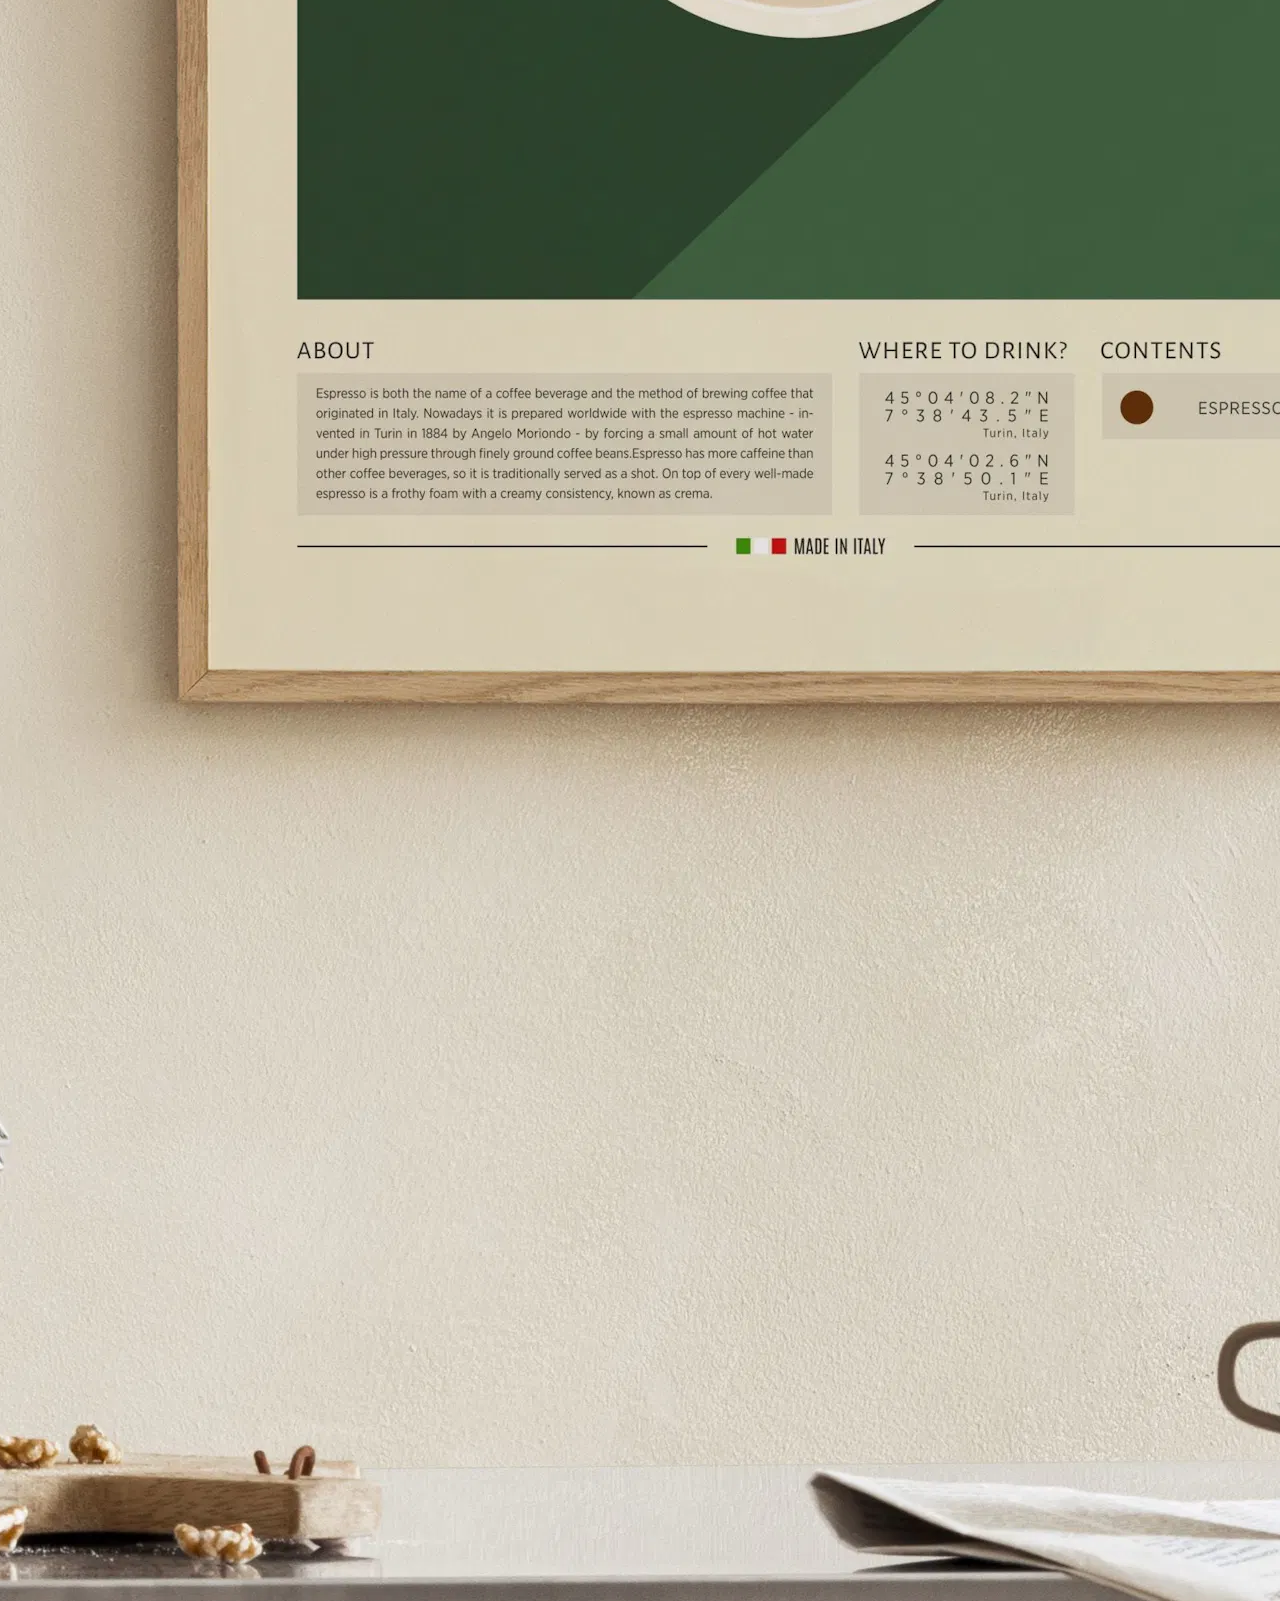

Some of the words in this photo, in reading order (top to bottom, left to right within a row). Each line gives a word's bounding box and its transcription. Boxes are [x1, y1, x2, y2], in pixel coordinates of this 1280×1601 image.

[297, 341, 374, 359] ABOUT
[859, 341, 942, 359] WHERE
[948, 341, 976, 359] TO
[986, 341, 1067, 359] DRINK?
[1101, 341, 1221, 359] CONTENTS
[316, 388, 366, 400] Espresso
[370, 388, 379, 398] is
[383, 388, 409, 399] both
[413, 388, 431, 398] the
[435, 390, 466, 399] name
[470, 388, 482, 399] of
[486, 390, 492, 399] a
[496, 388, 531, 399] coffee
[535, 388, 588, 400] beverage
[591, 388, 612, 398] and
[616, 388, 635, 399] the
[639, 388, 683, 399] method
[687, 388, 698, 399] of
[702, 388, 748, 400] brewing
[752, 388, 787, 398] coffee
[791, 388, 814, 399] that
[316, 408, 374, 420] originated
[379, 408, 388, 418] in
[393, 408, 418, 420] Italy.
[424, 408, 482, 420] Nowadays
[487, 408, 494, 419] it
[499, 408, 507, 418] is
[512, 408, 563, 420] prepared
[568, 408, 627, 419] worldwide
[631, 408, 656, 418] with
[660, 408, 678, 418] the
[683, 410, 732, 420] espresso
[737, 408, 785, 418] machine
[799, 408, 813, 418] in-
[316, 428, 355, 439] vented
[360, 428, 369, 438] in
[374, 428, 402, 439] Turin
[408, 428, 417, 438] in
[422, 428, 448, 439] 1884
[453, 428, 467, 440] by
[471, 428, 512, 440] Angelo
[517, 428, 571, 438] Moriondo
[585, 428, 599, 440] by
[604, 428, 643, 440] forcing
[648, 430, 654, 439] a
[659, 428, 688, 439] small
[693, 429, 737, 439] amount
[742, 428, 753, 438] of
[758, 428, 777, 438] hot
[782, 429, 813, 439] water
[983, 428, 1016, 438] Turin,
[1023, 428, 1049, 439] Italy
[316, 448, 349, 459] under
[352, 448, 377, 460] high
[380, 450, 428, 460] pressure
[431, 448, 476, 460] through
[479, 448, 510, 460] finely
[513, 448, 554, 460] ground
[557, 448, 592, 459] coffee
[686, 448, 704, 459] has
[708, 450, 737, 459] more
[740, 448, 785, 459] caffeine
[788, 448, 813, 458] than
[316, 468, 346, 479] other
[350, 468, 385, 479] coffee
[389, 468, 450, 480] beverages,
[453, 470, 466, 479] so
[470, 468, 477, 479] it
[481, 468, 489, 479] is
[492, 468, 560, 480] traditionally
[564, 468, 601, 479] served
[605, 470, 617, 479] as
[621, 471, 627, 479] a
[631, 468, 658, 479] shot.
[662, 468, 678, 479] On
[682, 468, 701, 480] top
[705, 468, 716, 478] of
[720, 470, 750, 480] every
[754, 468, 813, 479] well-made
[316, 490, 365, 500] espresso
[370, 488, 378, 498] is
[381, 491, 388, 499] a
[392, 488, 425, 500] frothy
[429, 488, 458, 499] foam
[462, 488, 486, 499] with
[500, 490, 542, 501] creamy
[546, 488, 613, 500] consistency,
[618, 488, 655, 499] known
[659, 490, 671, 498] as
[675, 490, 712, 499] crema.
[983, 491, 1016, 501] Turin,
[1022, 491, 1049, 502] Italy
[794, 537, 829, 555] MADE
[835, 538, 848, 555] IN
[854, 538, 886, 555] ITALY
